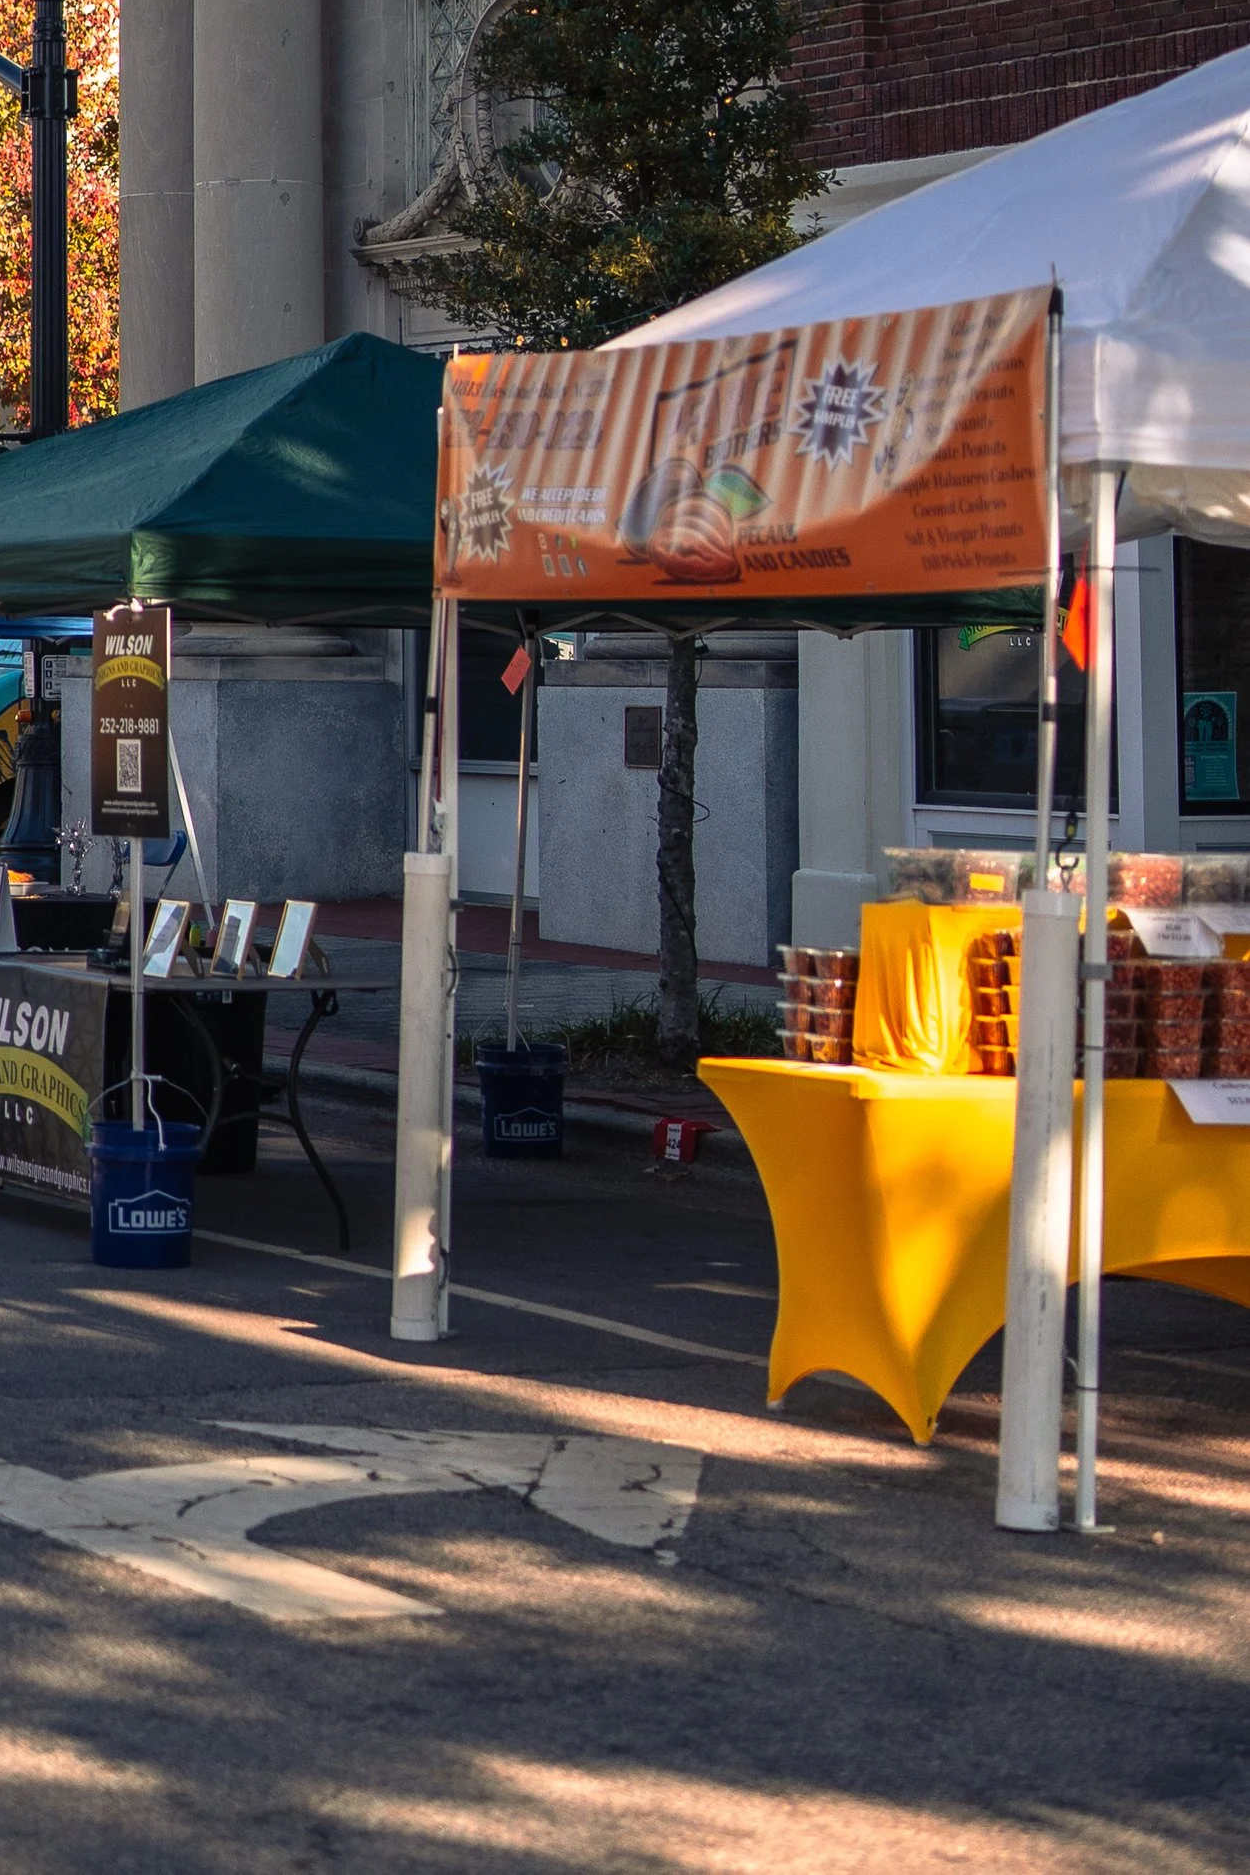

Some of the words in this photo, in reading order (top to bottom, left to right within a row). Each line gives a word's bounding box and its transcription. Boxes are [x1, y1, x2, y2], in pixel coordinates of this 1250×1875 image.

[824, 384, 860, 408] FREE
[470, 487, 494, 510] FREE
[960, 496, 1007, 515] Cashews
[937, 526, 979, 548] Vinegar
[981, 523, 1024, 540] Peanuts
[743, 553, 776, 573] AND
[777, 546, 851, 571] CANDIES
[974, 550, 1018, 567] Peanuts
[105, 634, 154, 656] WILSON
[1009, 636, 1031, 647] LLC
[117, 660, 129, 672] AND
[129, 660, 161, 680] GRAPHICS
[121, 678, 137, 688] LLC
[100, 717, 159, 735] 252-218-9881
[20, 1063, 86, 1124] GRAPHICS
[4, 1100, 34, 1125] LLC
[500, 1119, 557, 1137] LOWE'S
[118, 1206, 187, 1228] LOWE'S
